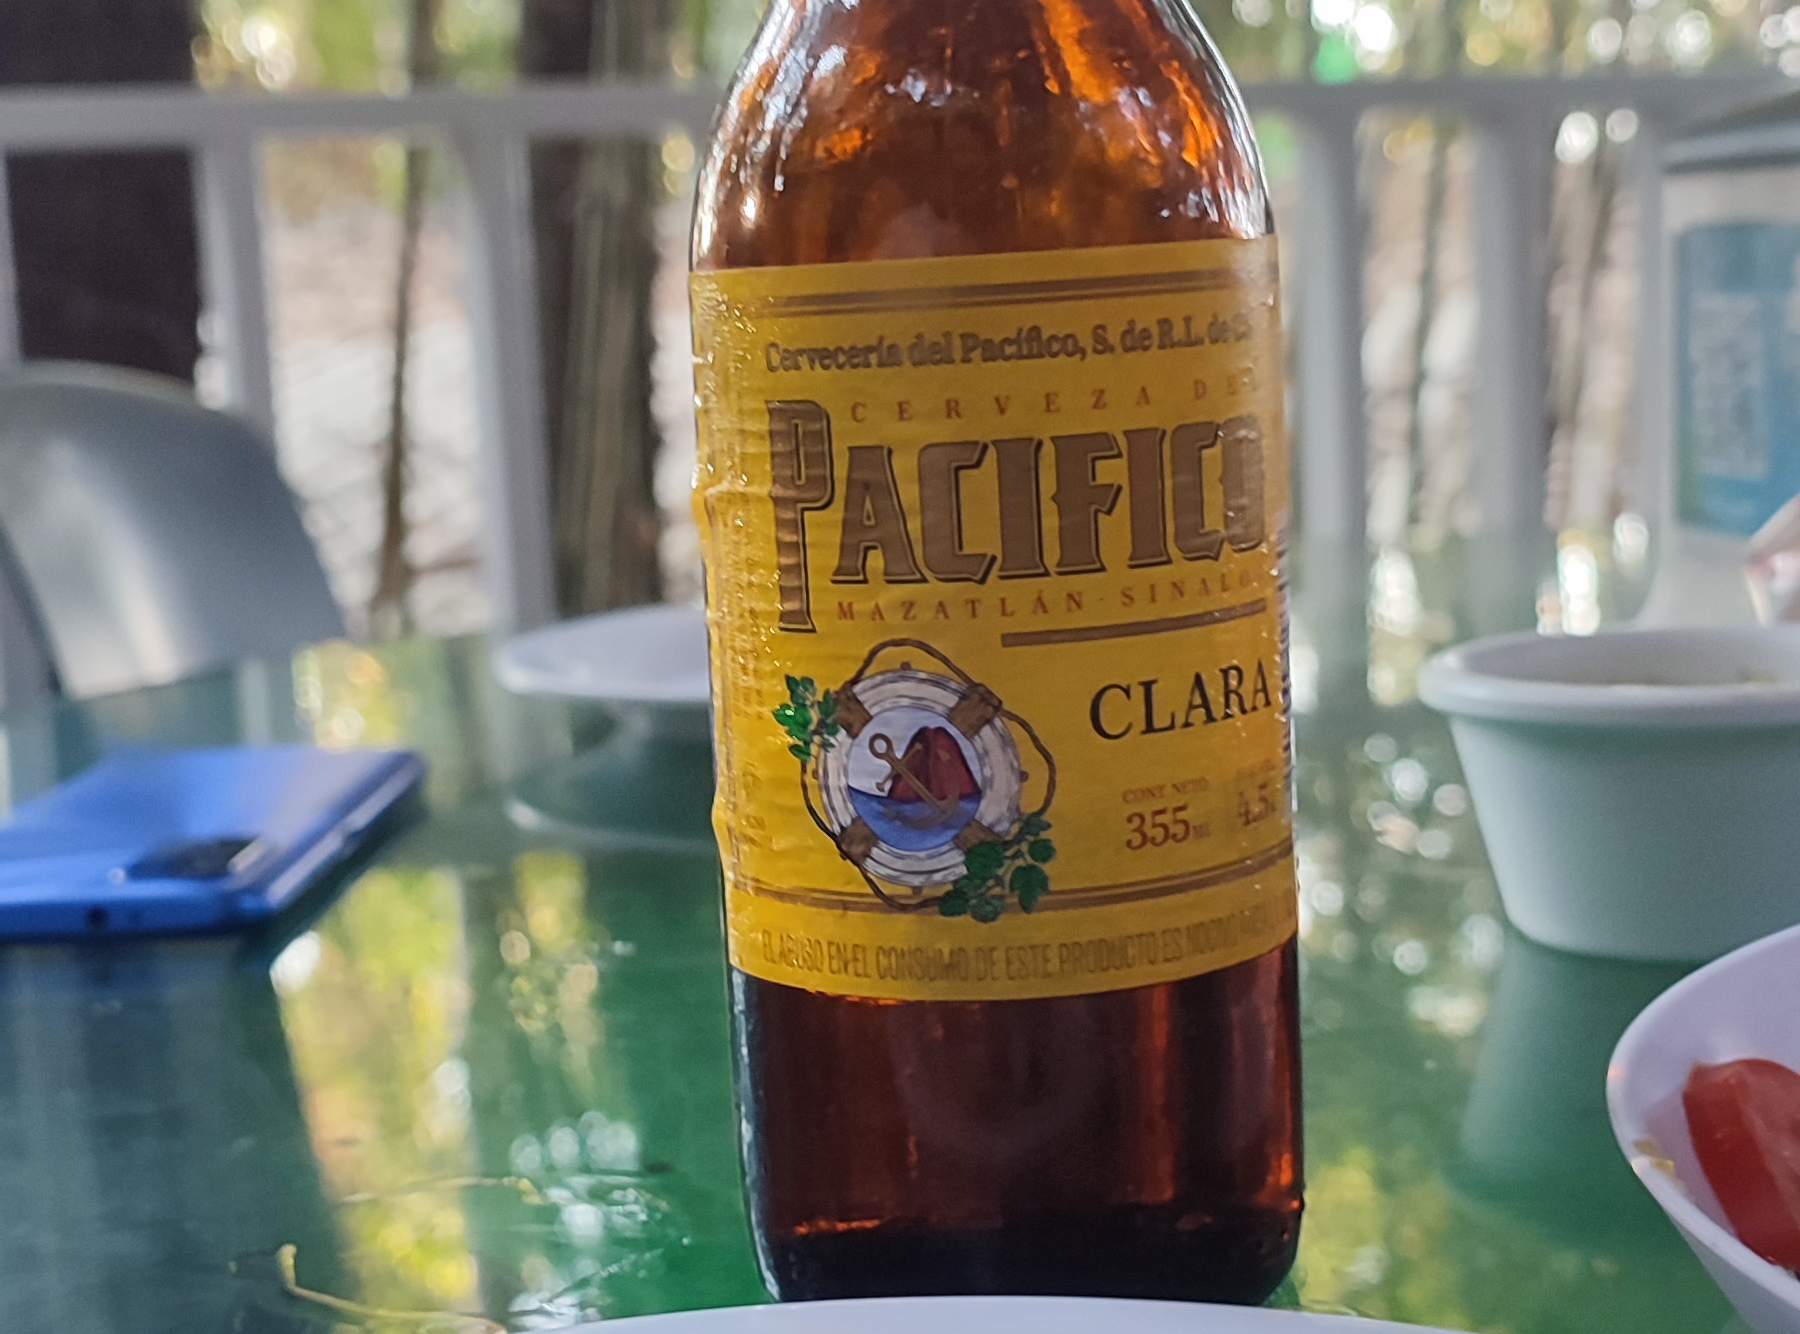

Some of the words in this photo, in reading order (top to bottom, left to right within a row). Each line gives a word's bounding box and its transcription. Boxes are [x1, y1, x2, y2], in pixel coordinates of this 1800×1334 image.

[766, 334, 901, 371] Cervecería
[909, 331, 955, 366] del
[960, 324, 1086, 364] Pacífico,
[1093, 324, 1115, 355] S.
[1120, 319, 1153, 353] de
[1157, 316, 1204, 350] R.L.
[852, 386, 1150, 422] CERVEZA
[765, 399, 1266, 633] PACIFICO
[837, 591, 1086, 622] MAZATLÁN
[1089, 658, 1272, 741] CLARA
[1126, 804, 1191, 850] 355
[762, 928, 777, 964] EL
[827, 940, 849, 975] EN
[852, 943, 872, 978] EL
[875, 945, 969, 981] CONSUMO
[974, 946, 1000, 982] DE
[1004, 944, 1050, 980] ESTE
[1058, 931, 1156, 972] PRODUCTO
[1161, 927, 1182, 962] ES
